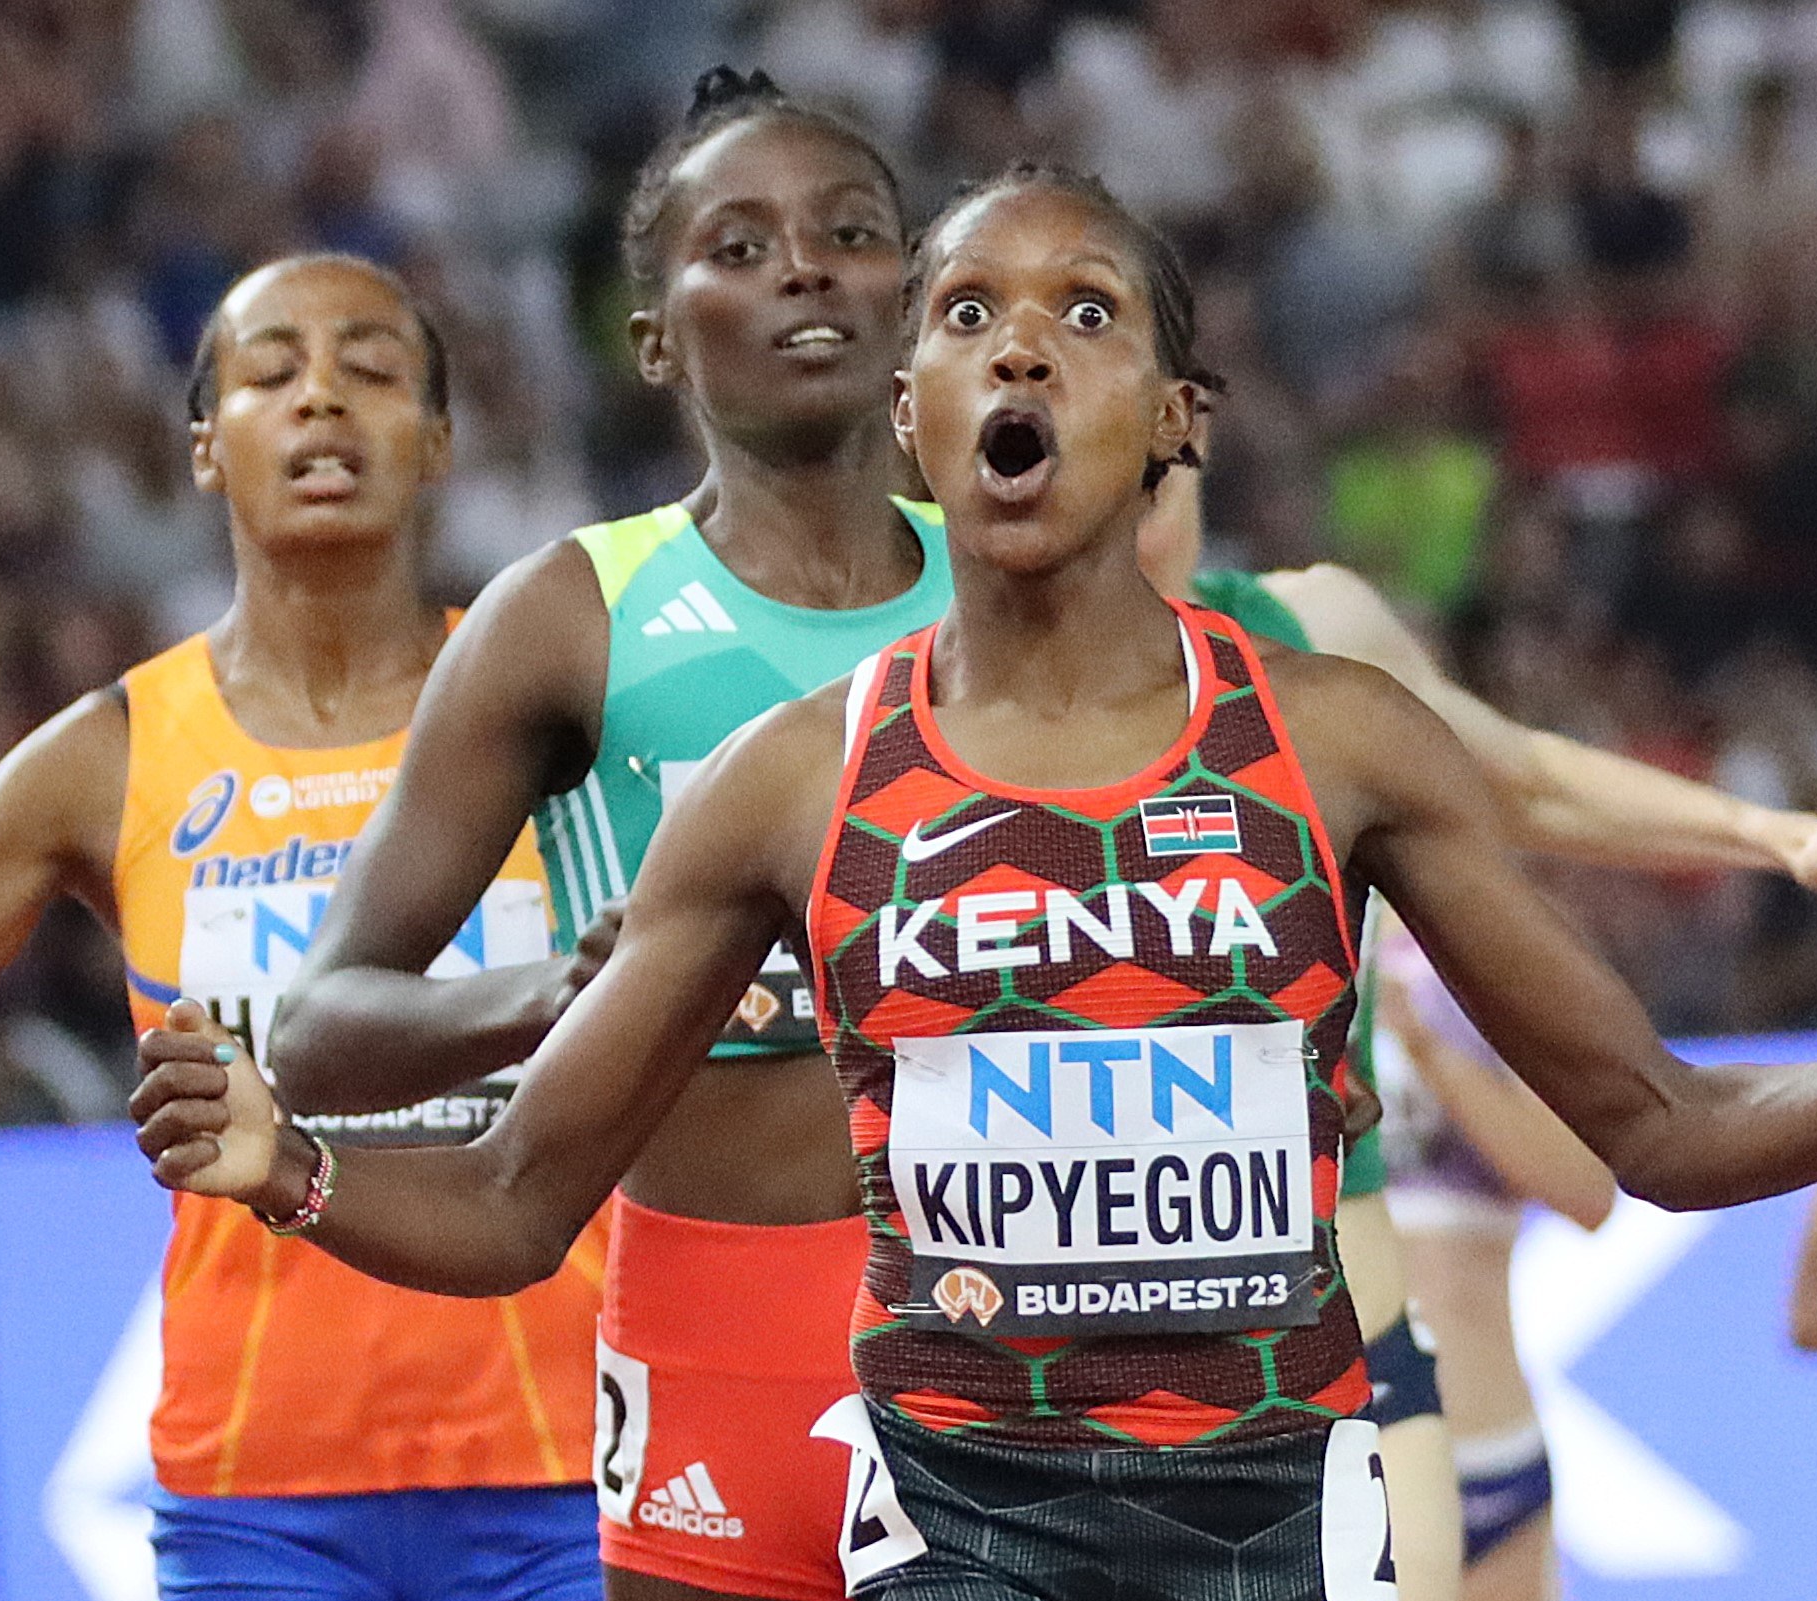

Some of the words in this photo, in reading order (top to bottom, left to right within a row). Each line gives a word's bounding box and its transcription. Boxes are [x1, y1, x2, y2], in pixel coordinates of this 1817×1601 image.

[878, 878, 1280, 987] KENYA
[967, 1034, 1234, 1140] NTN
[914, 1149, 1290, 1249] KIPYEGON
[1016, 1276, 1243, 1316] BUDAPEST
[1247, 1273, 1289, 1307] 23
[638, 1501, 745, 1539] adidas
